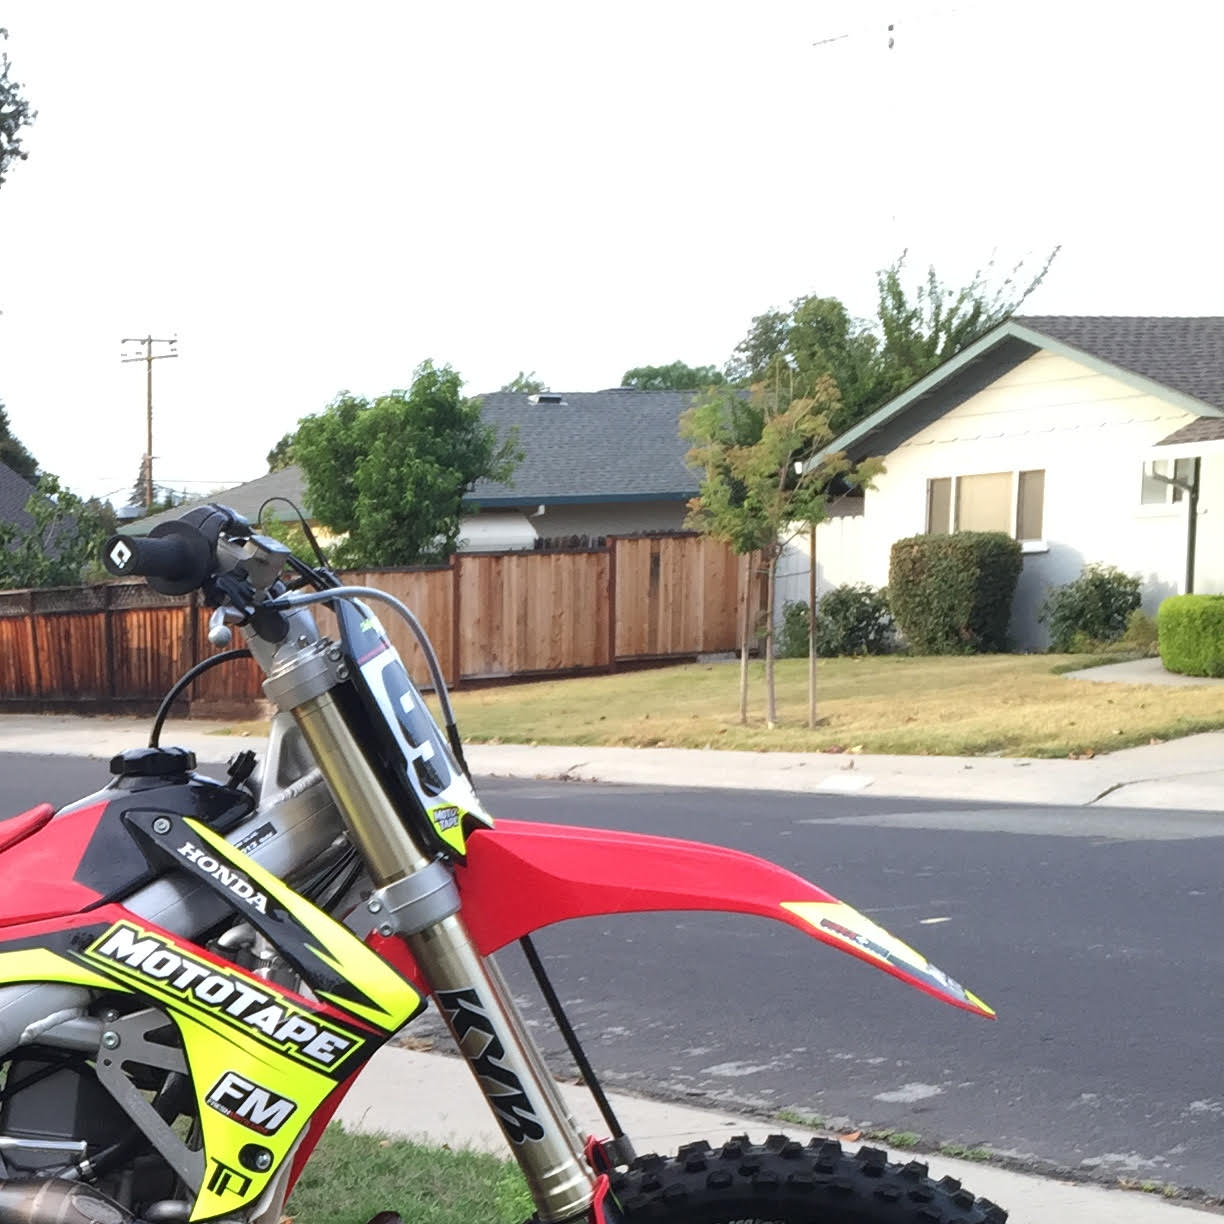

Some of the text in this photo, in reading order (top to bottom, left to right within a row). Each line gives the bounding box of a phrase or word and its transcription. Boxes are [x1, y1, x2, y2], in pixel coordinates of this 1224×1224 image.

[176, 841, 268, 915] HONDA
[98, 927, 350, 1063] MOTOTAPE
[208, 1073, 295, 1130] FM
[434, 986, 545, 1144] KYB
